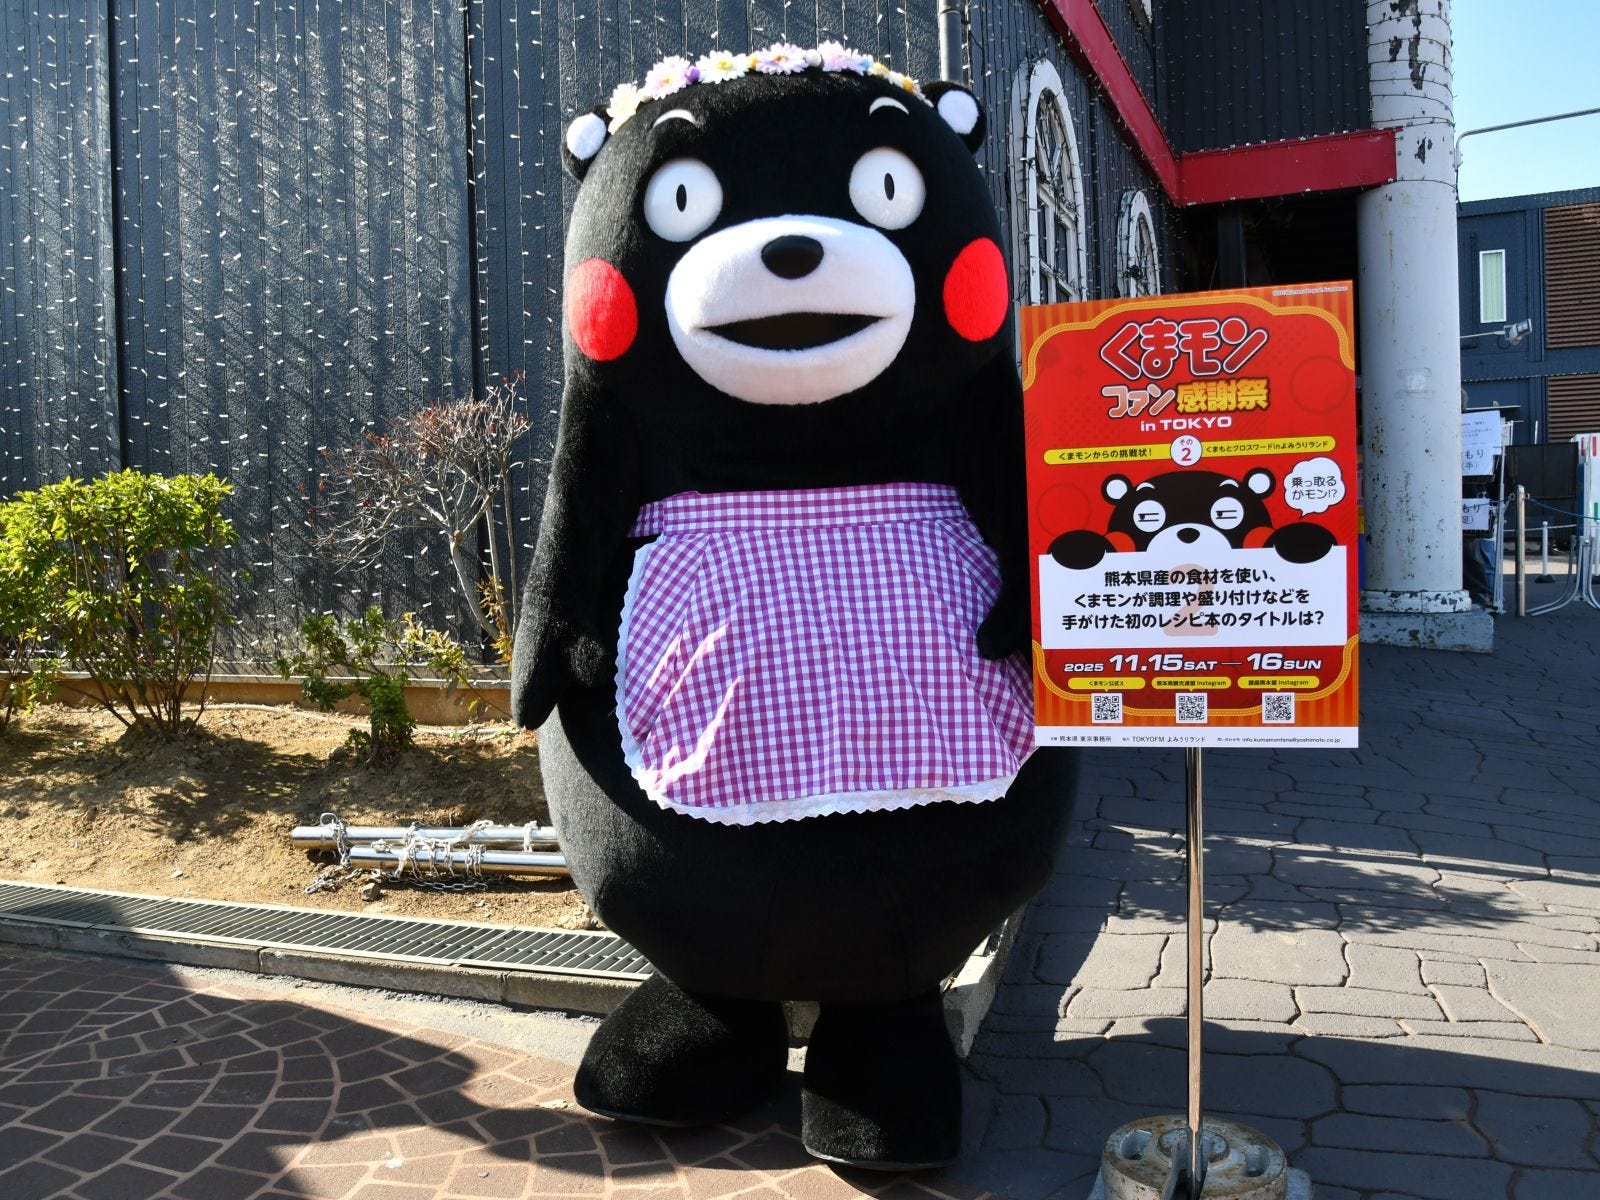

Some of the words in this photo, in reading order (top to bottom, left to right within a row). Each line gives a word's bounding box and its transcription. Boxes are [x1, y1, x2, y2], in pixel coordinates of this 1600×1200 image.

[1100, 317, 1268, 380] くまモン
[1101, 378, 1269, 417] ファン感謝祭
[1140, 420, 1156, 432] in
[1160, 416, 1232, 431] TOKYO
[1206, 440, 1329, 453] くまもとクロスワードinよみうりランド
[1059, 448, 1152, 461] くまモンからの挑戦状！
[1181, 447, 1192, 461] 2
[1292, 476, 1337, 488] 乗っ取る
[1292, 488, 1338, 501] かモン!?
[1104, 568, 1276, 587] 熊本県産の食材を使い、
[1074, 589, 1310, 608] くまモンが調理や盛り付けなどを
[1061, 610, 1324, 630] 手がけた初のレシピ本のタイトルは？
[1064, 663, 1104, 672] 2025
[1196, 680, 1227, 688] Instagram
[1279, 679, 1309, 688] Instagram
